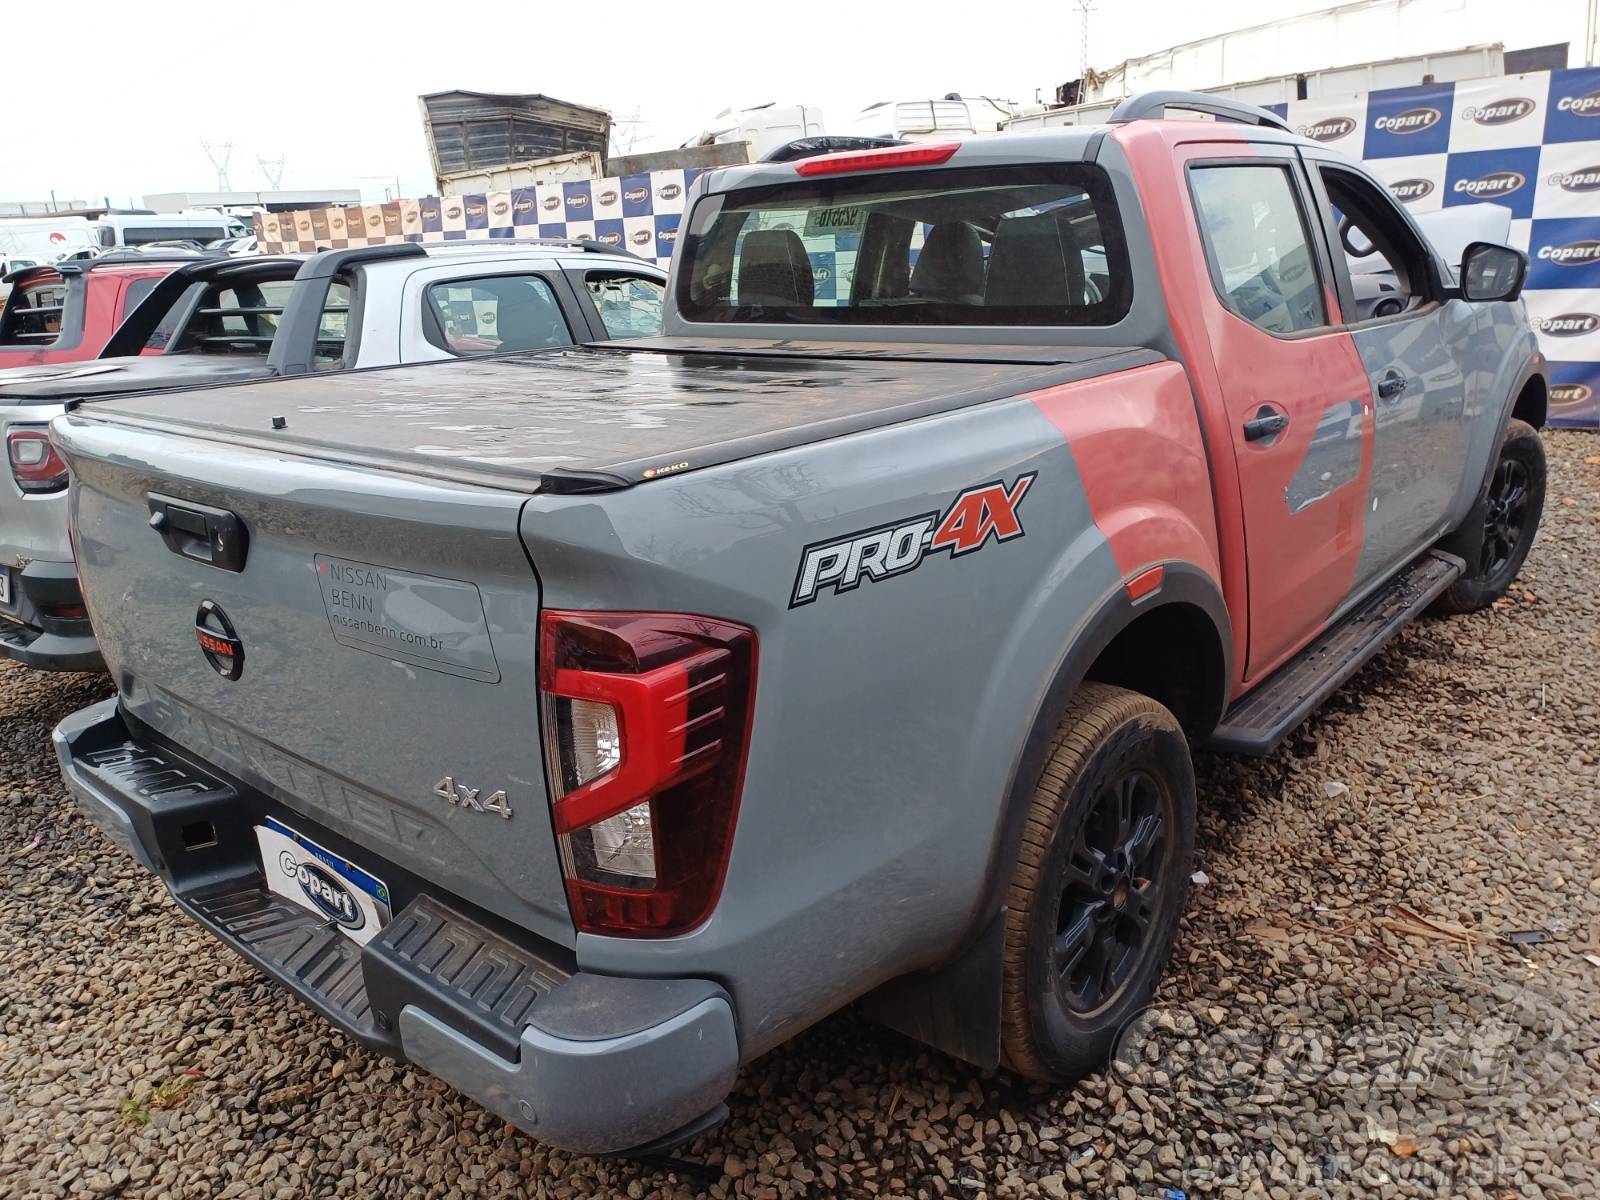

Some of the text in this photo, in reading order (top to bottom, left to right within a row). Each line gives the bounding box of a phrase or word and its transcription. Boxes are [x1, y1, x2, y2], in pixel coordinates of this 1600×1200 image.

[1462, 102, 1524, 120] Copart
[1557, 96, 1600, 112] Copa
[1375, 111, 1432, 130] Copart
[1391, 182, 1424, 196] part
[1454, 176, 1516, 193] Copart
[1548, 172, 1600, 188] Copar
[625, 190, 646, 201] Copart
[659, 231, 677, 240] Copar
[1531, 317, 1592, 332] Copart
[788, 470, 1038, 609] PRO-4X
[331, 563, 387, 592] NISSAN
[331, 588, 373, 614] BENN
[332, 614, 445, 651] nissanbenn.com.br
[433, 776, 513, 820] 4x4
[280, 850, 353, 921] Copart
